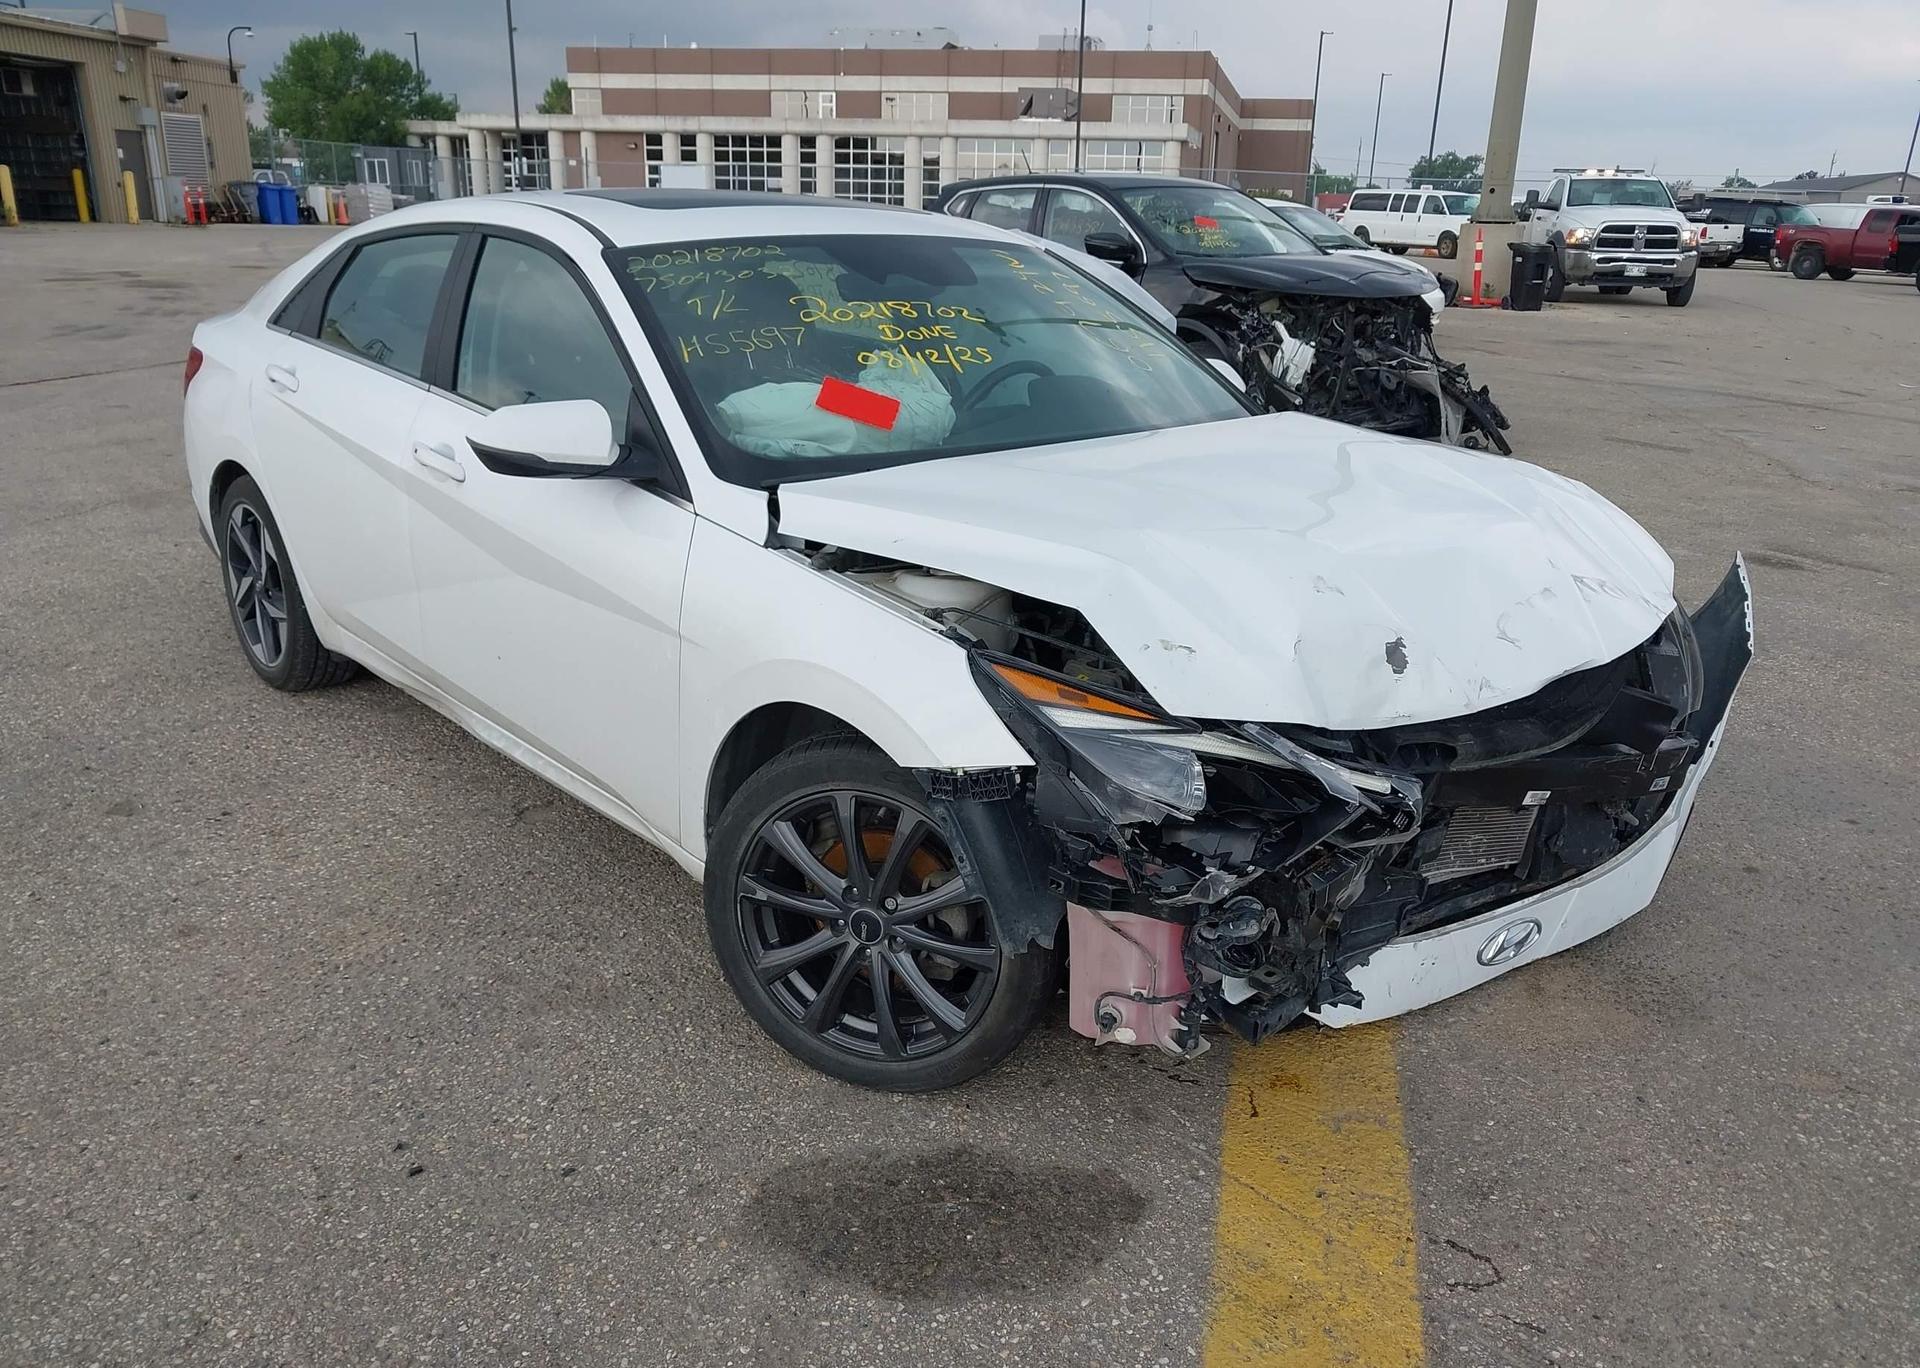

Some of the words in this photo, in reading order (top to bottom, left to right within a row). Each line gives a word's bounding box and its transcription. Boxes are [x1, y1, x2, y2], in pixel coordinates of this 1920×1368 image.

[627, 245, 786, 273] 20218702
[789, 295, 986, 323] 20218702
[878, 324, 957, 341] DONE
[857, 343, 993, 375] 08/12/25
